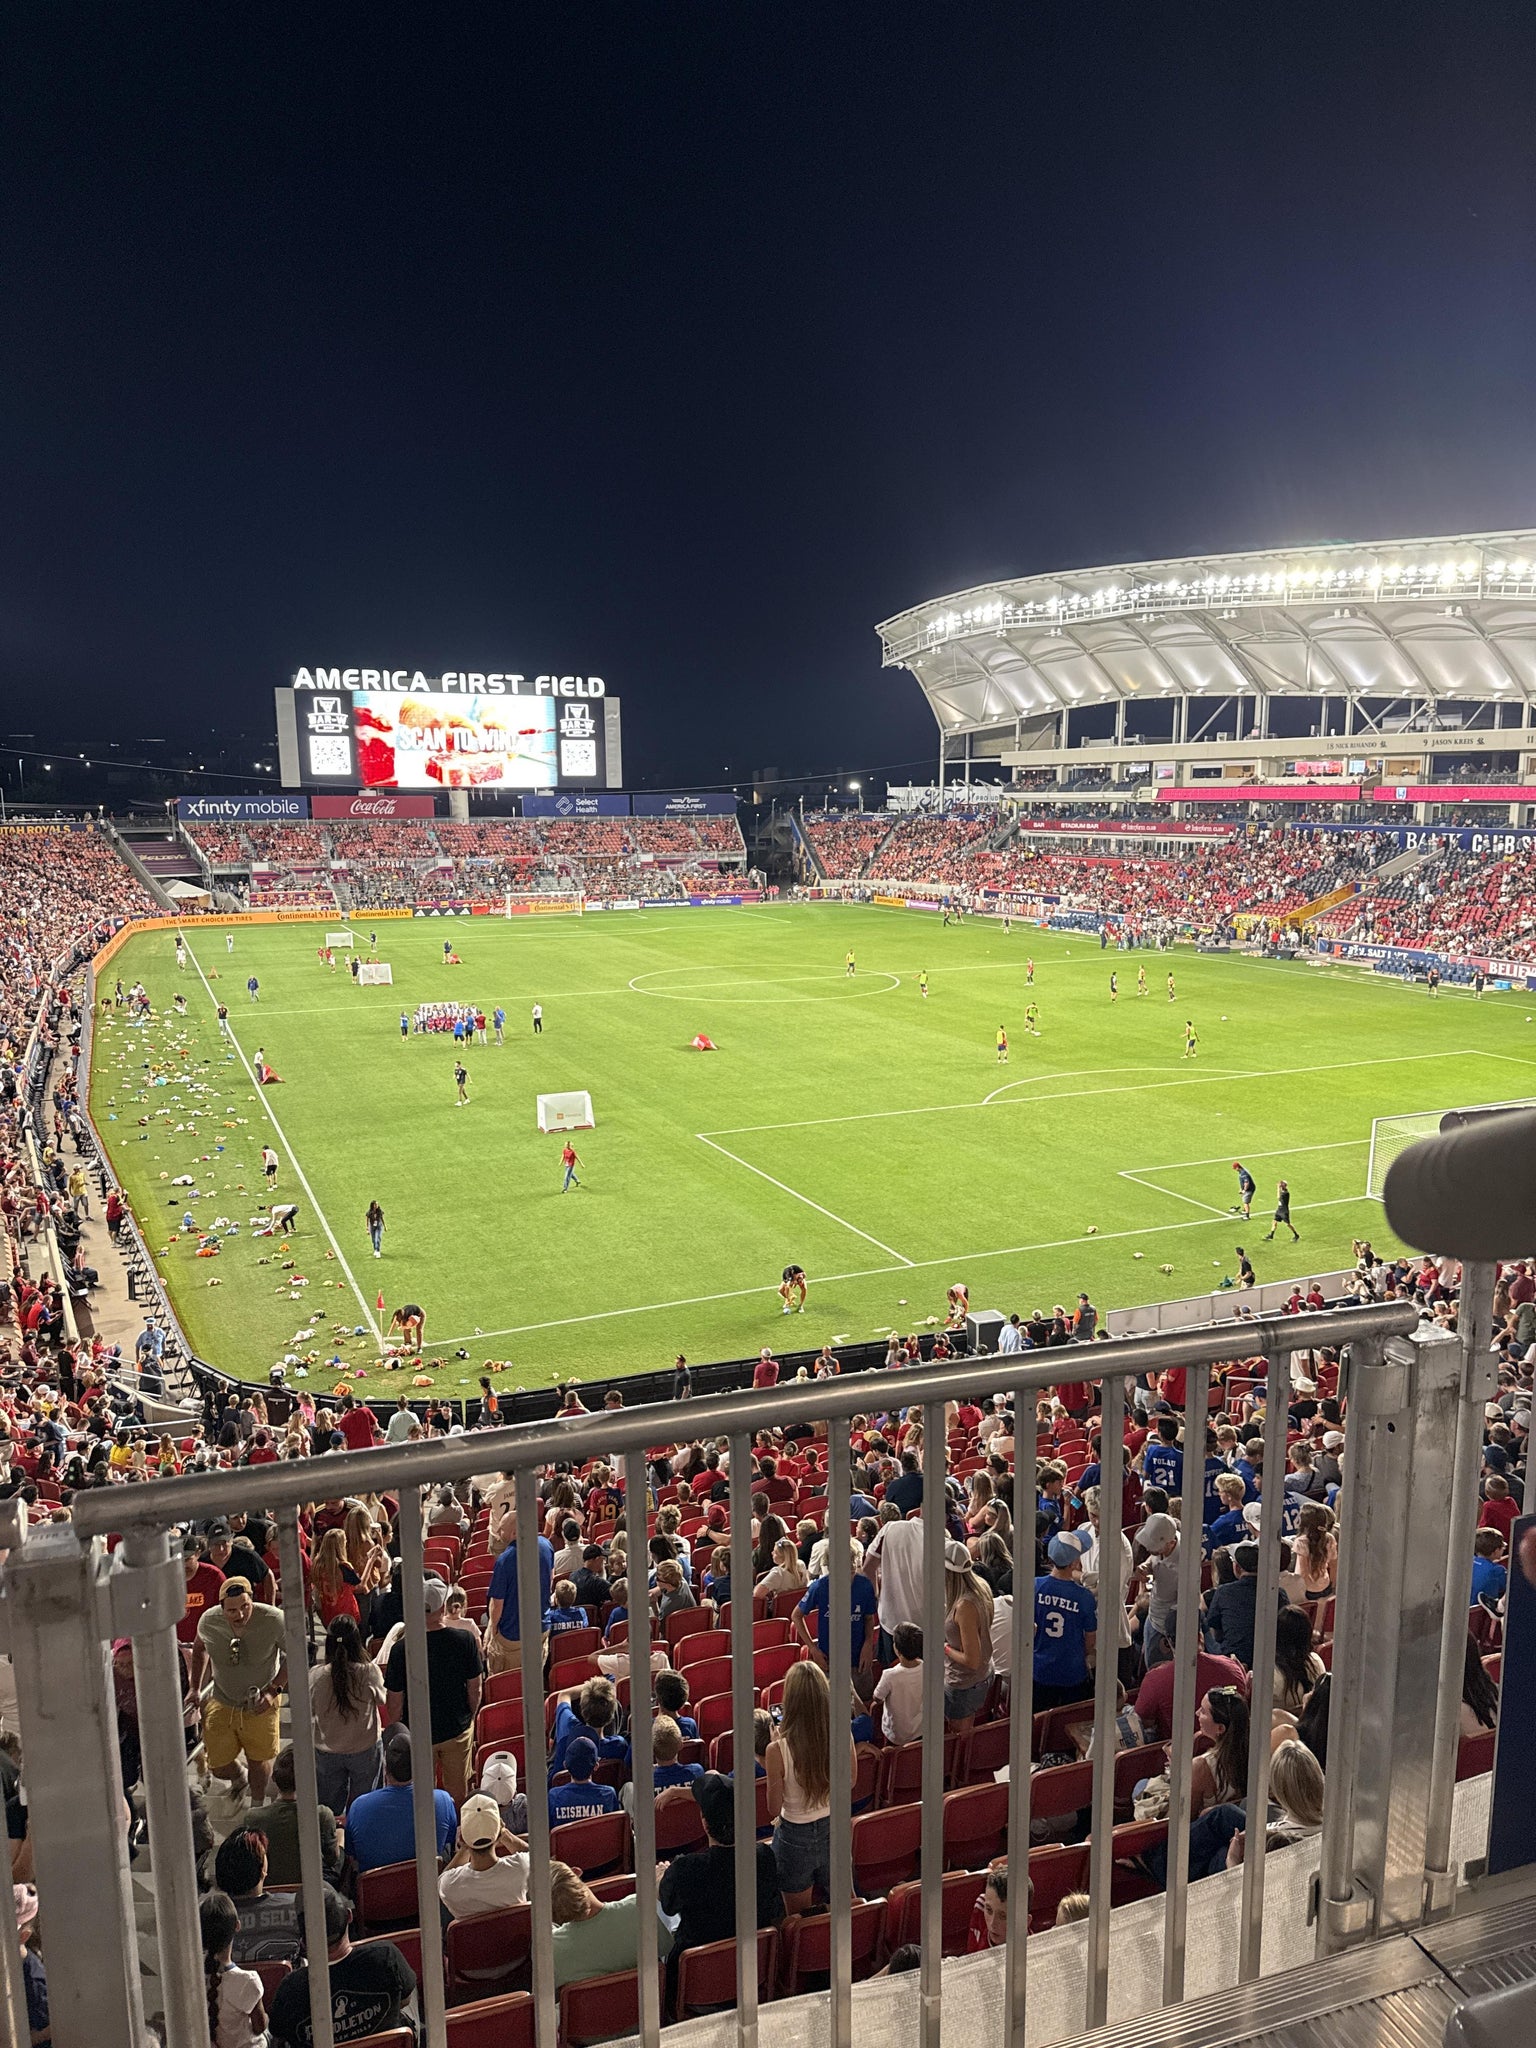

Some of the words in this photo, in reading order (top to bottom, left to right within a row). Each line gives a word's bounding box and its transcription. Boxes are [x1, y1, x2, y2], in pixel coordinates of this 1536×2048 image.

[293, 667, 431, 692] AMERICA
[441, 672, 525, 695] FIRST
[534, 675, 606, 698] FIELD
[399, 726, 446, 751] SCAN
[450, 728, 478, 752] TO
[1423, 739, 1428, 747] 9
[1432, 739, 1452, 747] JASON
[187, 799, 242, 816] xfinity
[245, 800, 299, 814] mobile
[350, 799, 398, 815] Coca-Cola
[575, 798, 598, 806] Select
[27, 825, 71, 834] ROYALS
[178, 917, 199, 925] SMART
[277, 911, 318, 921] Continental
[355, 910, 389, 918] Continental
[1152, 1457, 1176, 1468] FOLAU
[1154, 1468, 1176, 1486] 21
[600, 1504, 616, 1521] 19
[1038, 1593, 1079, 1613] LOVELL
[1045, 1611, 1065, 1638] 3
[555, 1804, 604, 1820] LEISHMAN
[305, 2004, 381, 2041] PDLETON
